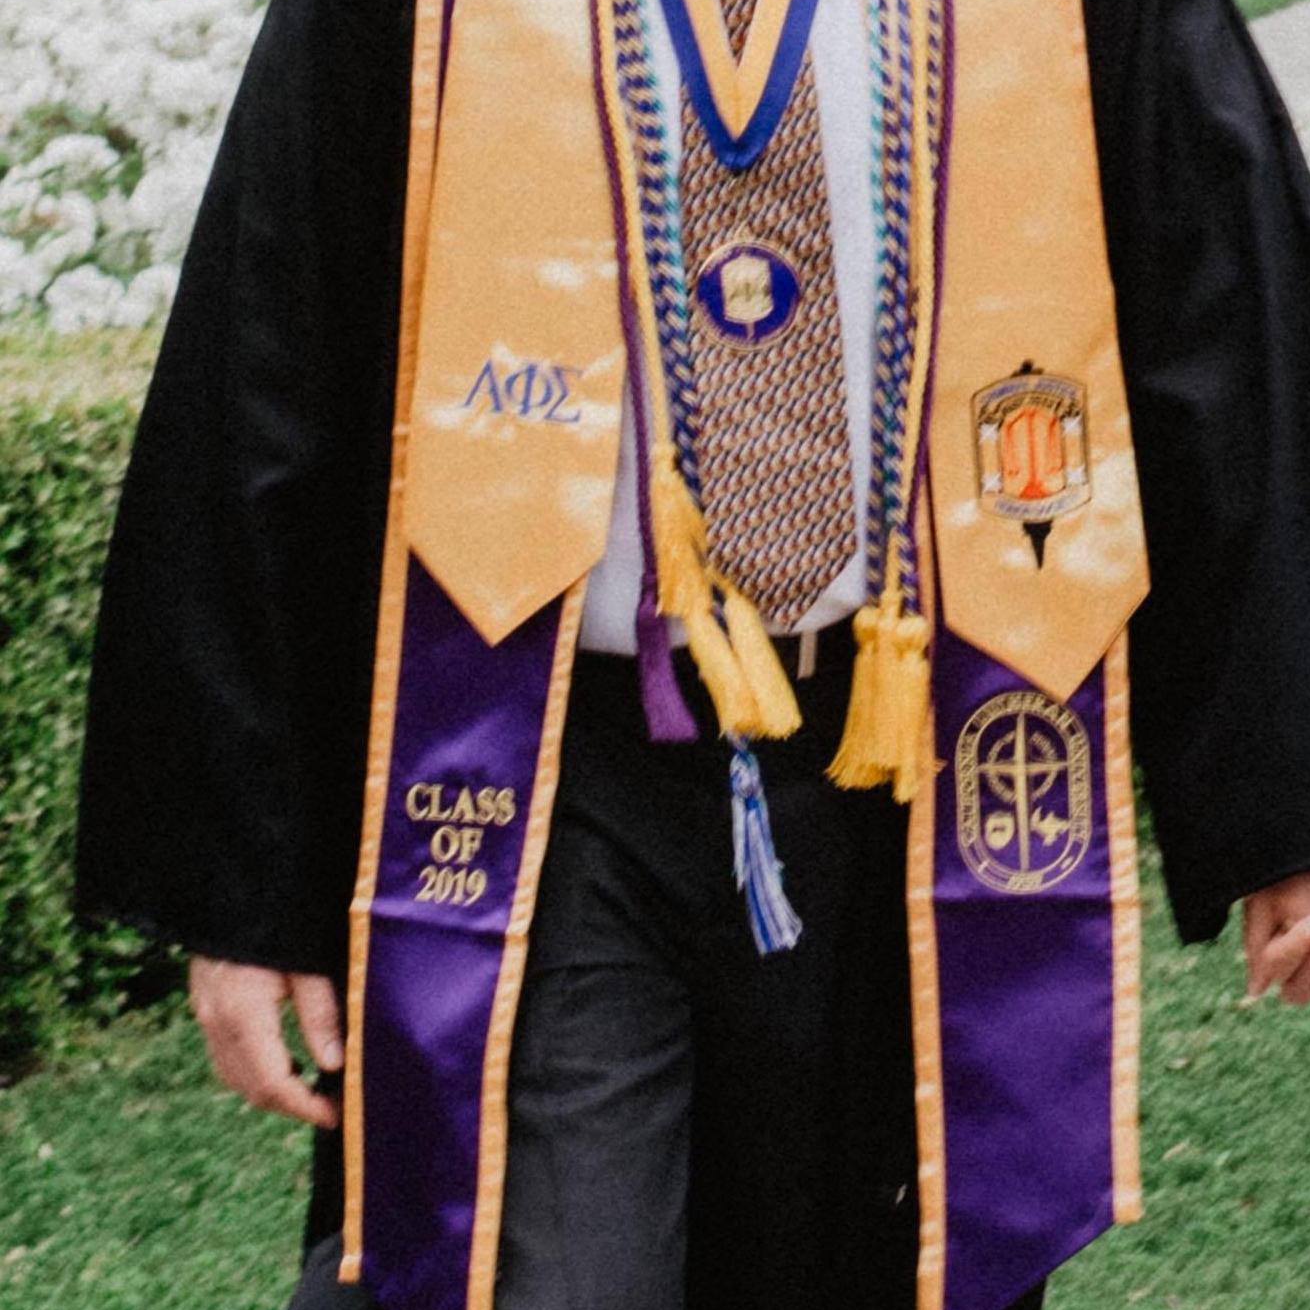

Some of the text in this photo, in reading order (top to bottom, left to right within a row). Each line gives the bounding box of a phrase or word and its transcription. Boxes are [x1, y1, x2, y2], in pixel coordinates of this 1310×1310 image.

[405, 782, 516, 827] CLASS
[430, 824, 484, 865] OF
[414, 865, 488, 907] 2019
